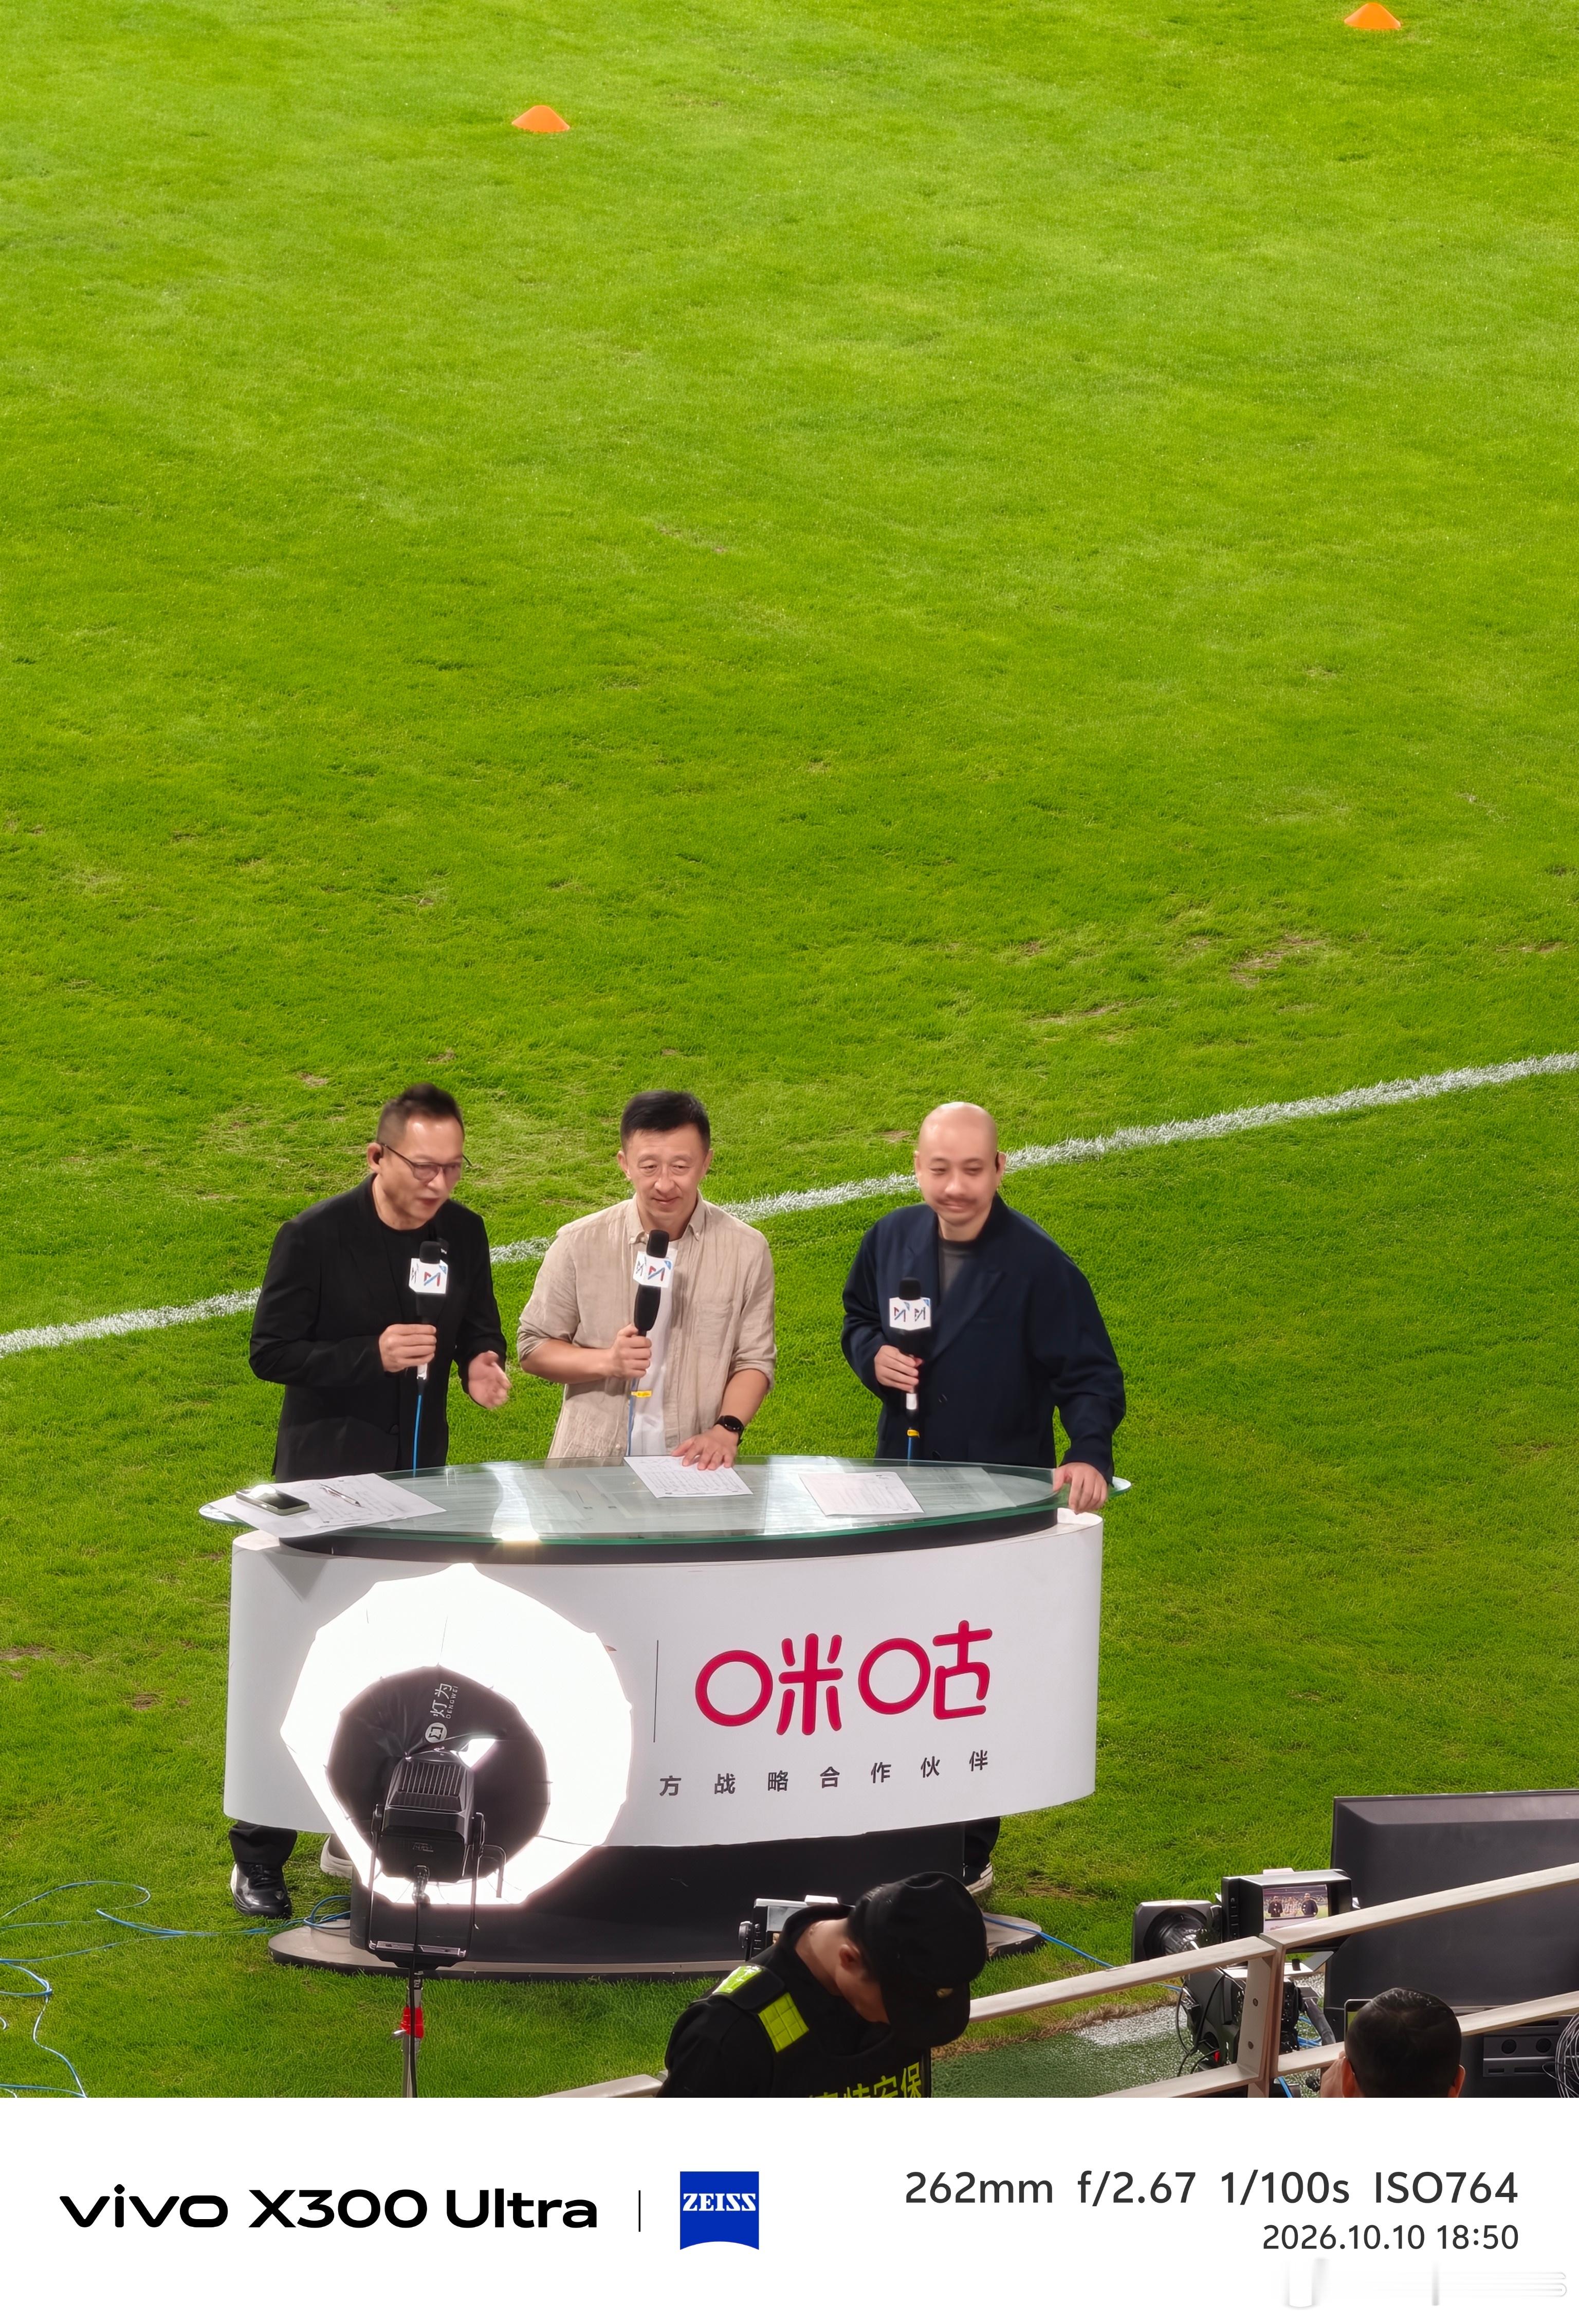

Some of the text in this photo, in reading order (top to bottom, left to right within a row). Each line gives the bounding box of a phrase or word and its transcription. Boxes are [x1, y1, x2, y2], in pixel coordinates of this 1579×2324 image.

[430, 1683, 452, 1718] 灯为
[695, 1620, 993, 1735] 咪咕
[659, 1750, 988, 1796] 方战略合作伙伴
